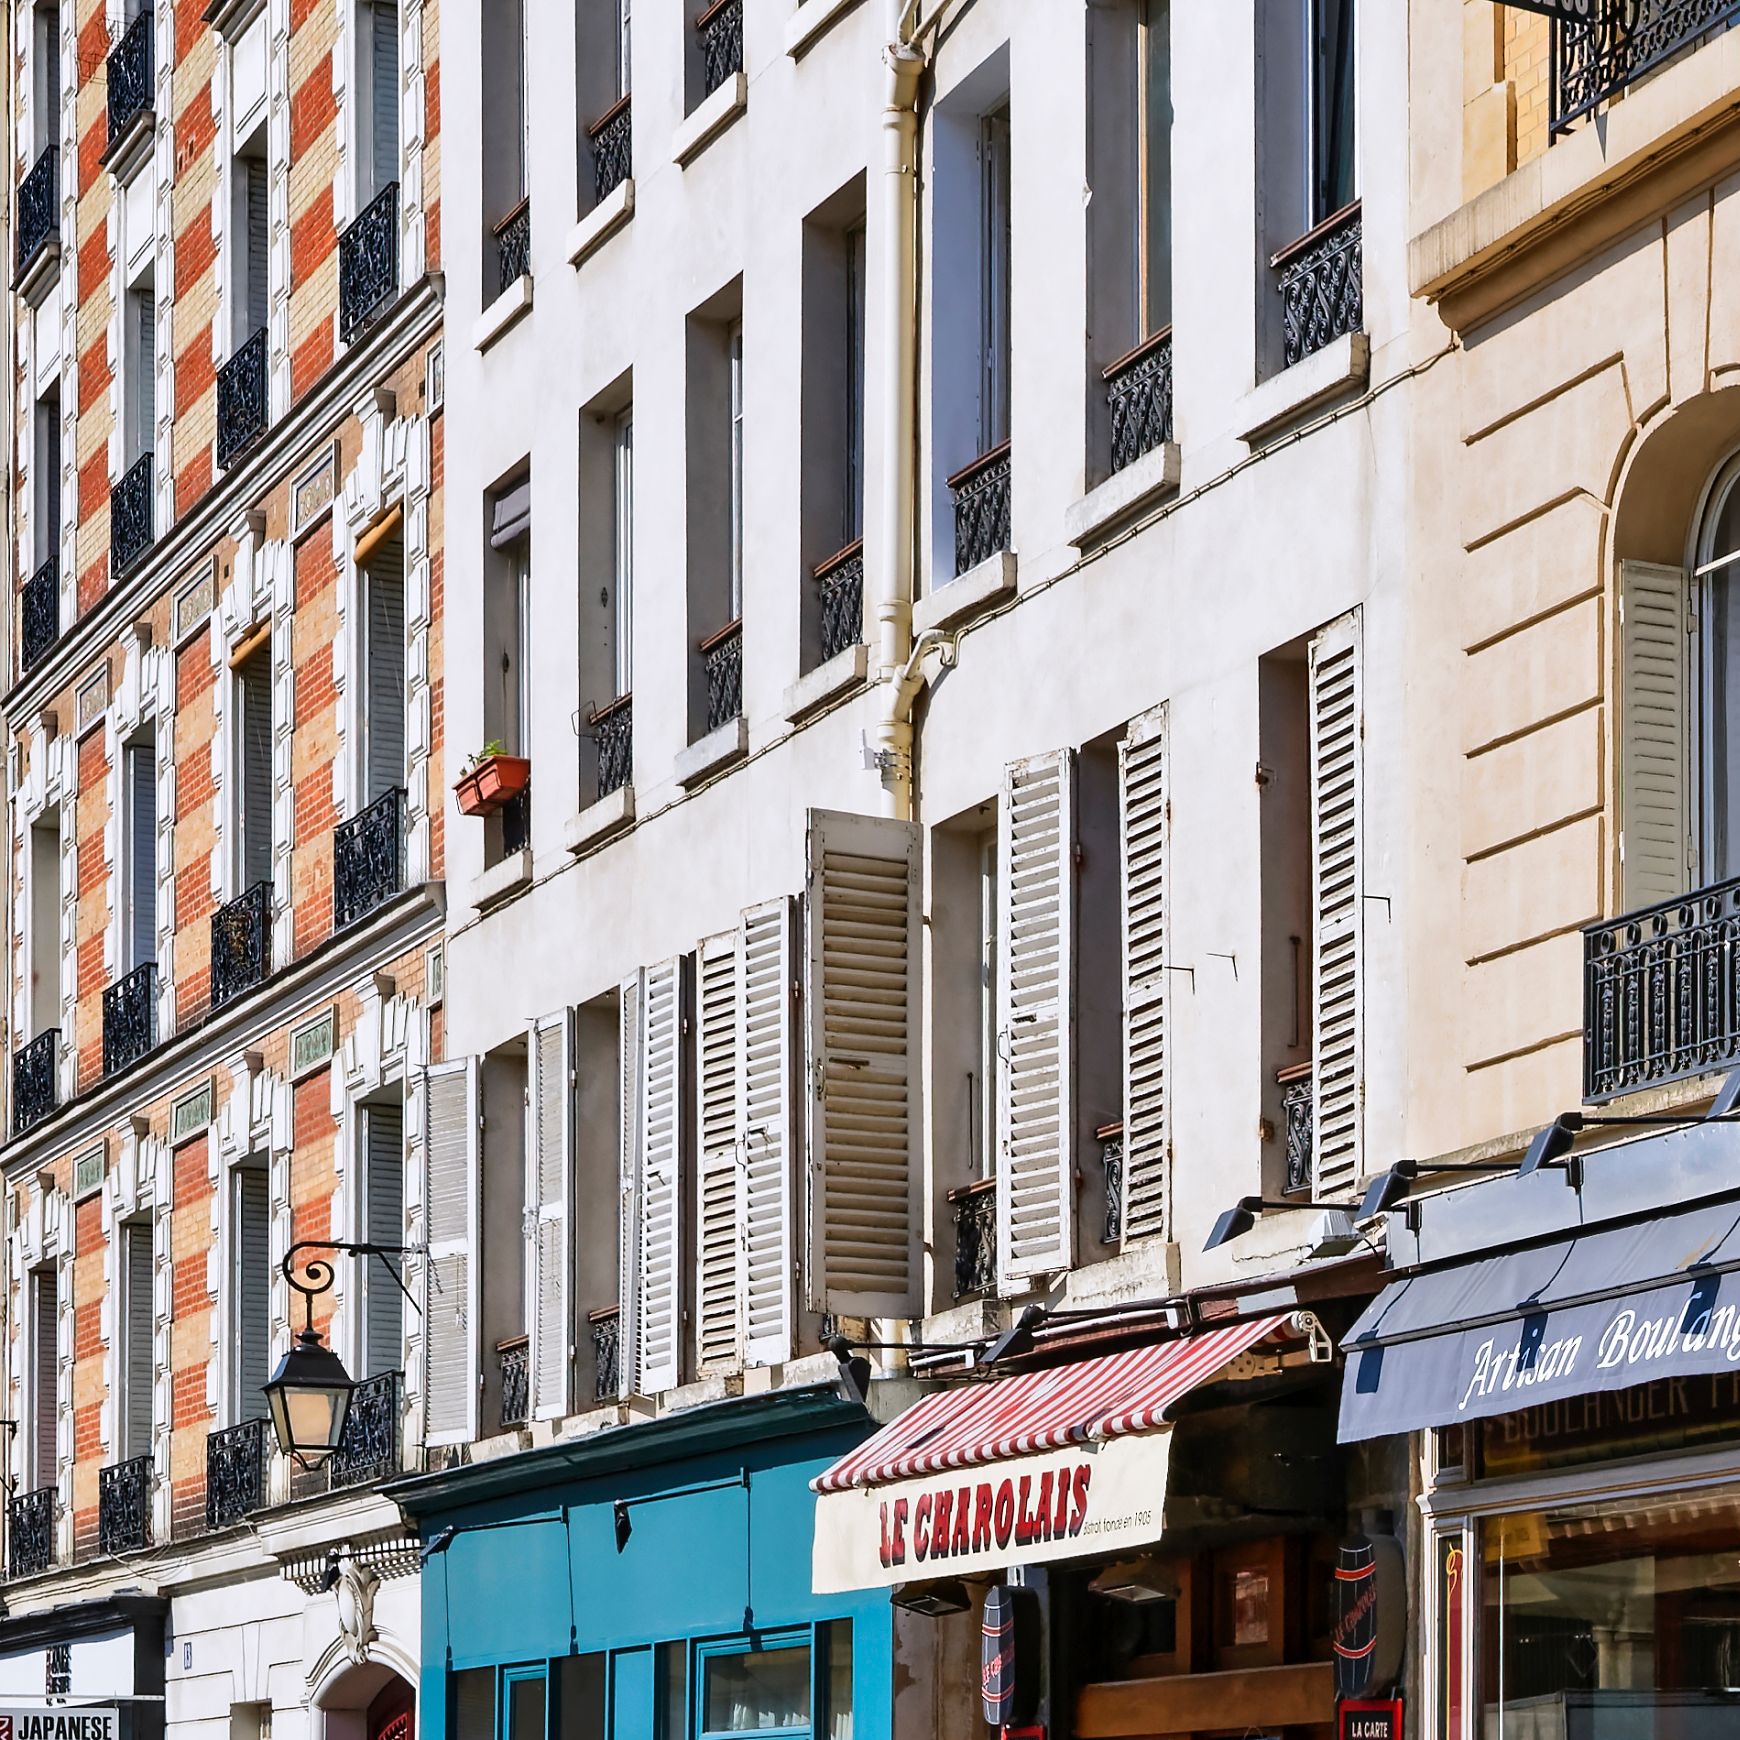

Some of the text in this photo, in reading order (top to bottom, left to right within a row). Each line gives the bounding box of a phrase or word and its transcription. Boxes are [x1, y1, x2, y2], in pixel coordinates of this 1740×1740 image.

[1459, 1327, 1583, 1410] Artisan
[879, 1464, 1091, 1569] LE CHAROLAIS
[1123, 1516, 1132, 1528] en
[1134, 1510, 1151, 1527] 1905
[18, 1716, 112, 1740] JAPANESE
[1351, 1721, 1388, 1739] LA CARTE
